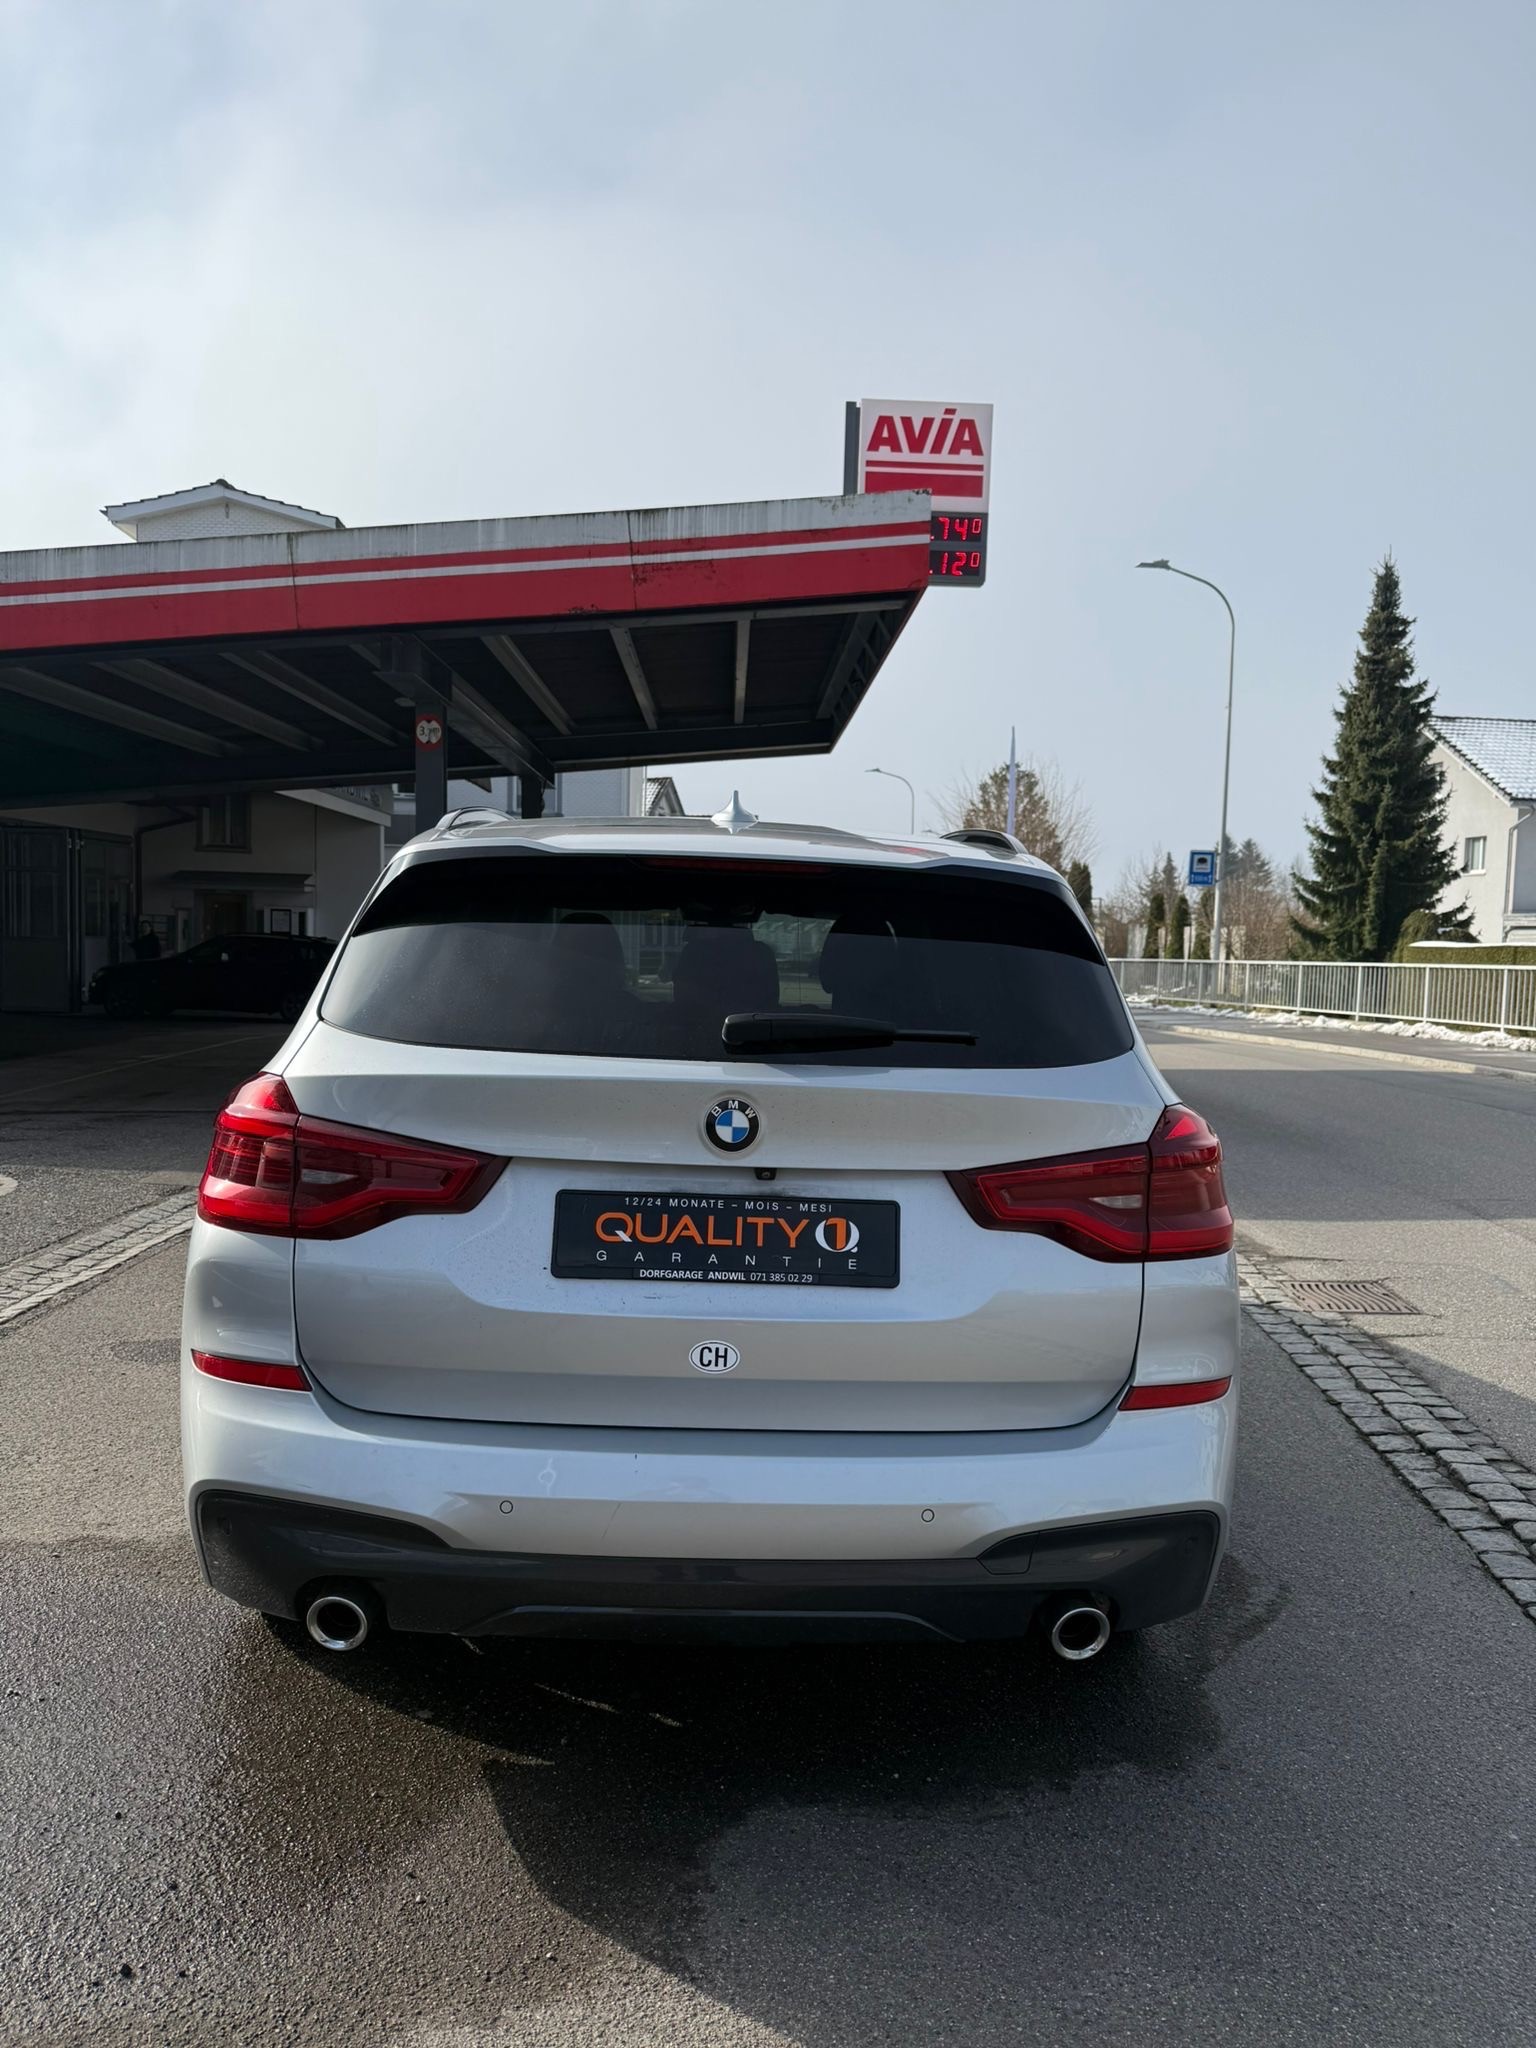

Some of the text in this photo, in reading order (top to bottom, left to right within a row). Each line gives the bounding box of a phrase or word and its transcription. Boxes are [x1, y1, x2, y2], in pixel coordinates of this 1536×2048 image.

[711, 1100, 756, 1119] BMW
[625, 1197, 661, 1207] 12/24
[669, 1198, 724, 1209] MONATE
[745, 1201, 779, 1211] MOIS
[799, 1203, 832, 1213] MESI
[595, 1211, 810, 1249] QUALITY
[596, 1250, 857, 1270] GARANTIE
[640, 1269, 813, 1283] DORFGARAGE ANDWIL 071 385 02 29
[699, 1346, 728, 1368] CH
